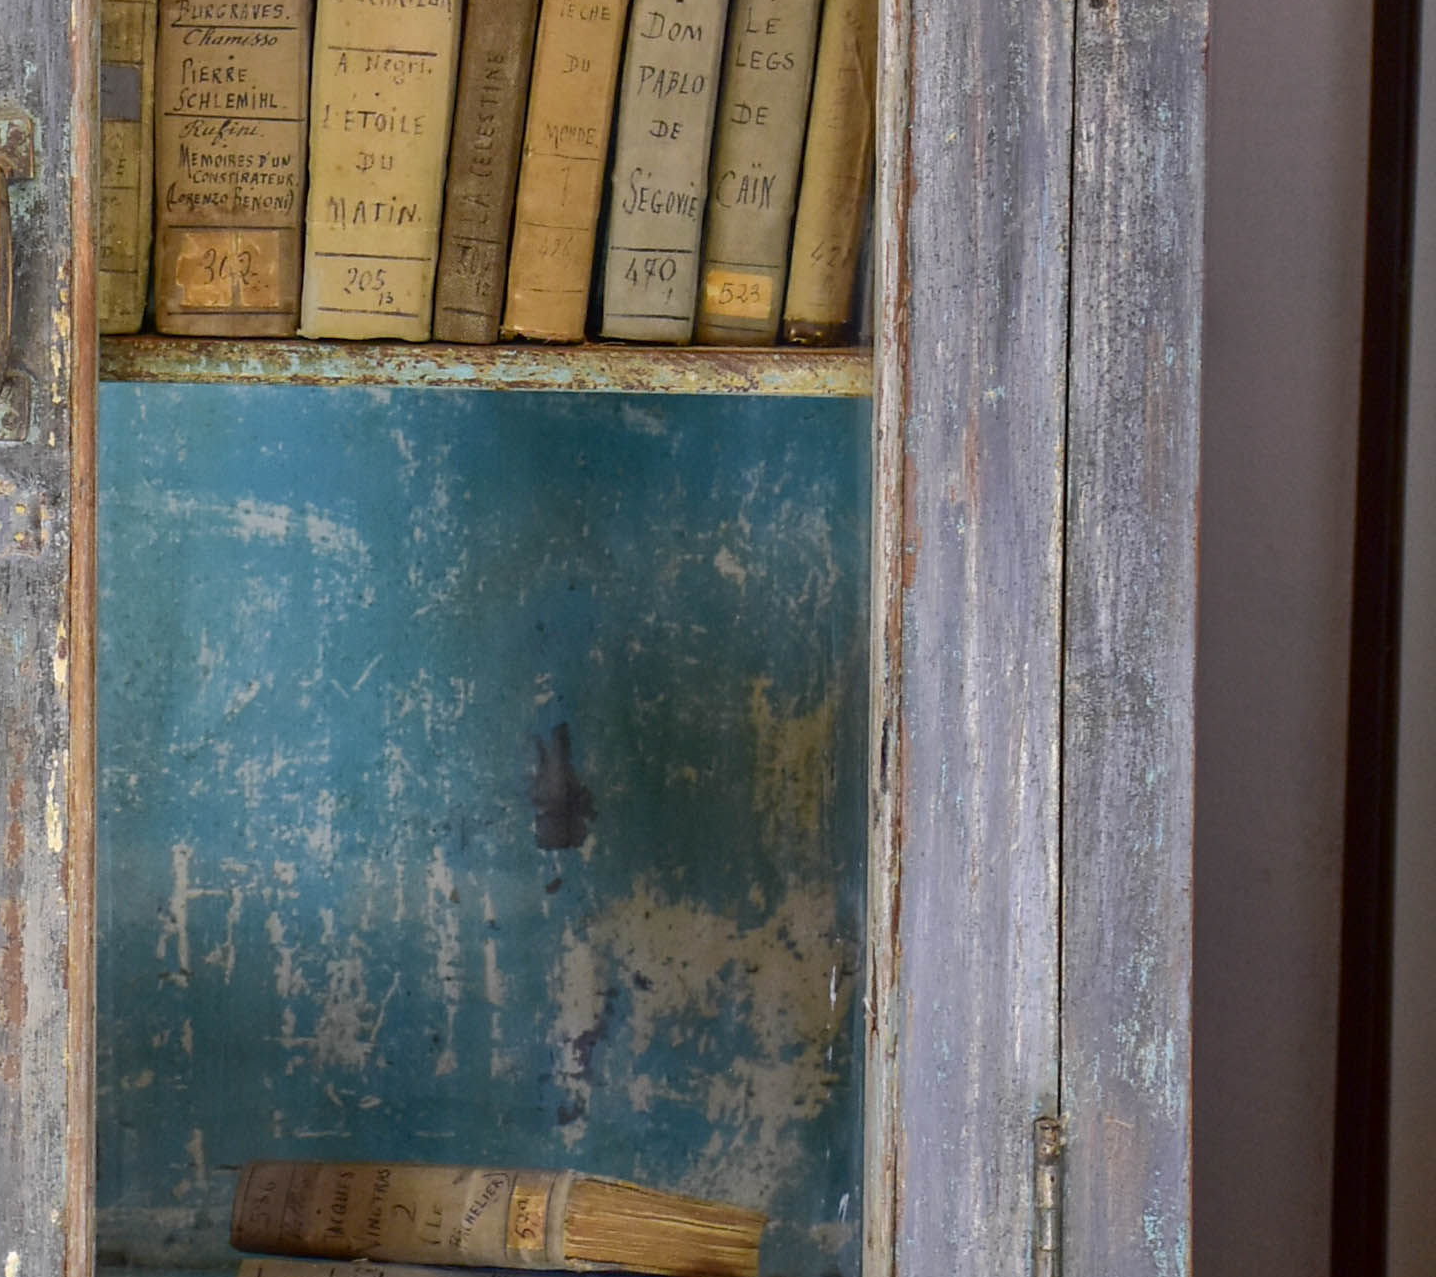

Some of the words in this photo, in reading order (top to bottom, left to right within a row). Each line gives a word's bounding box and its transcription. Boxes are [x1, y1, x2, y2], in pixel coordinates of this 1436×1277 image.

[640, 11, 703, 42] DOM
[745, 6, 781, 35] LE
[561, 52, 591, 74] DU
[734, 41, 795, 71] LEGS
[182, 57, 248, 86] PIERRE
[637, 65, 705, 99] PABLO
[730, 102, 770, 126] DE
[649, 119, 684, 141] DE
[355, 151, 394, 172] DU
[343, 266, 387, 295] 205
[624, 256, 677, 291] 470
[718, 282, 760, 305] 523
[393, 1203, 418, 1223] 2
